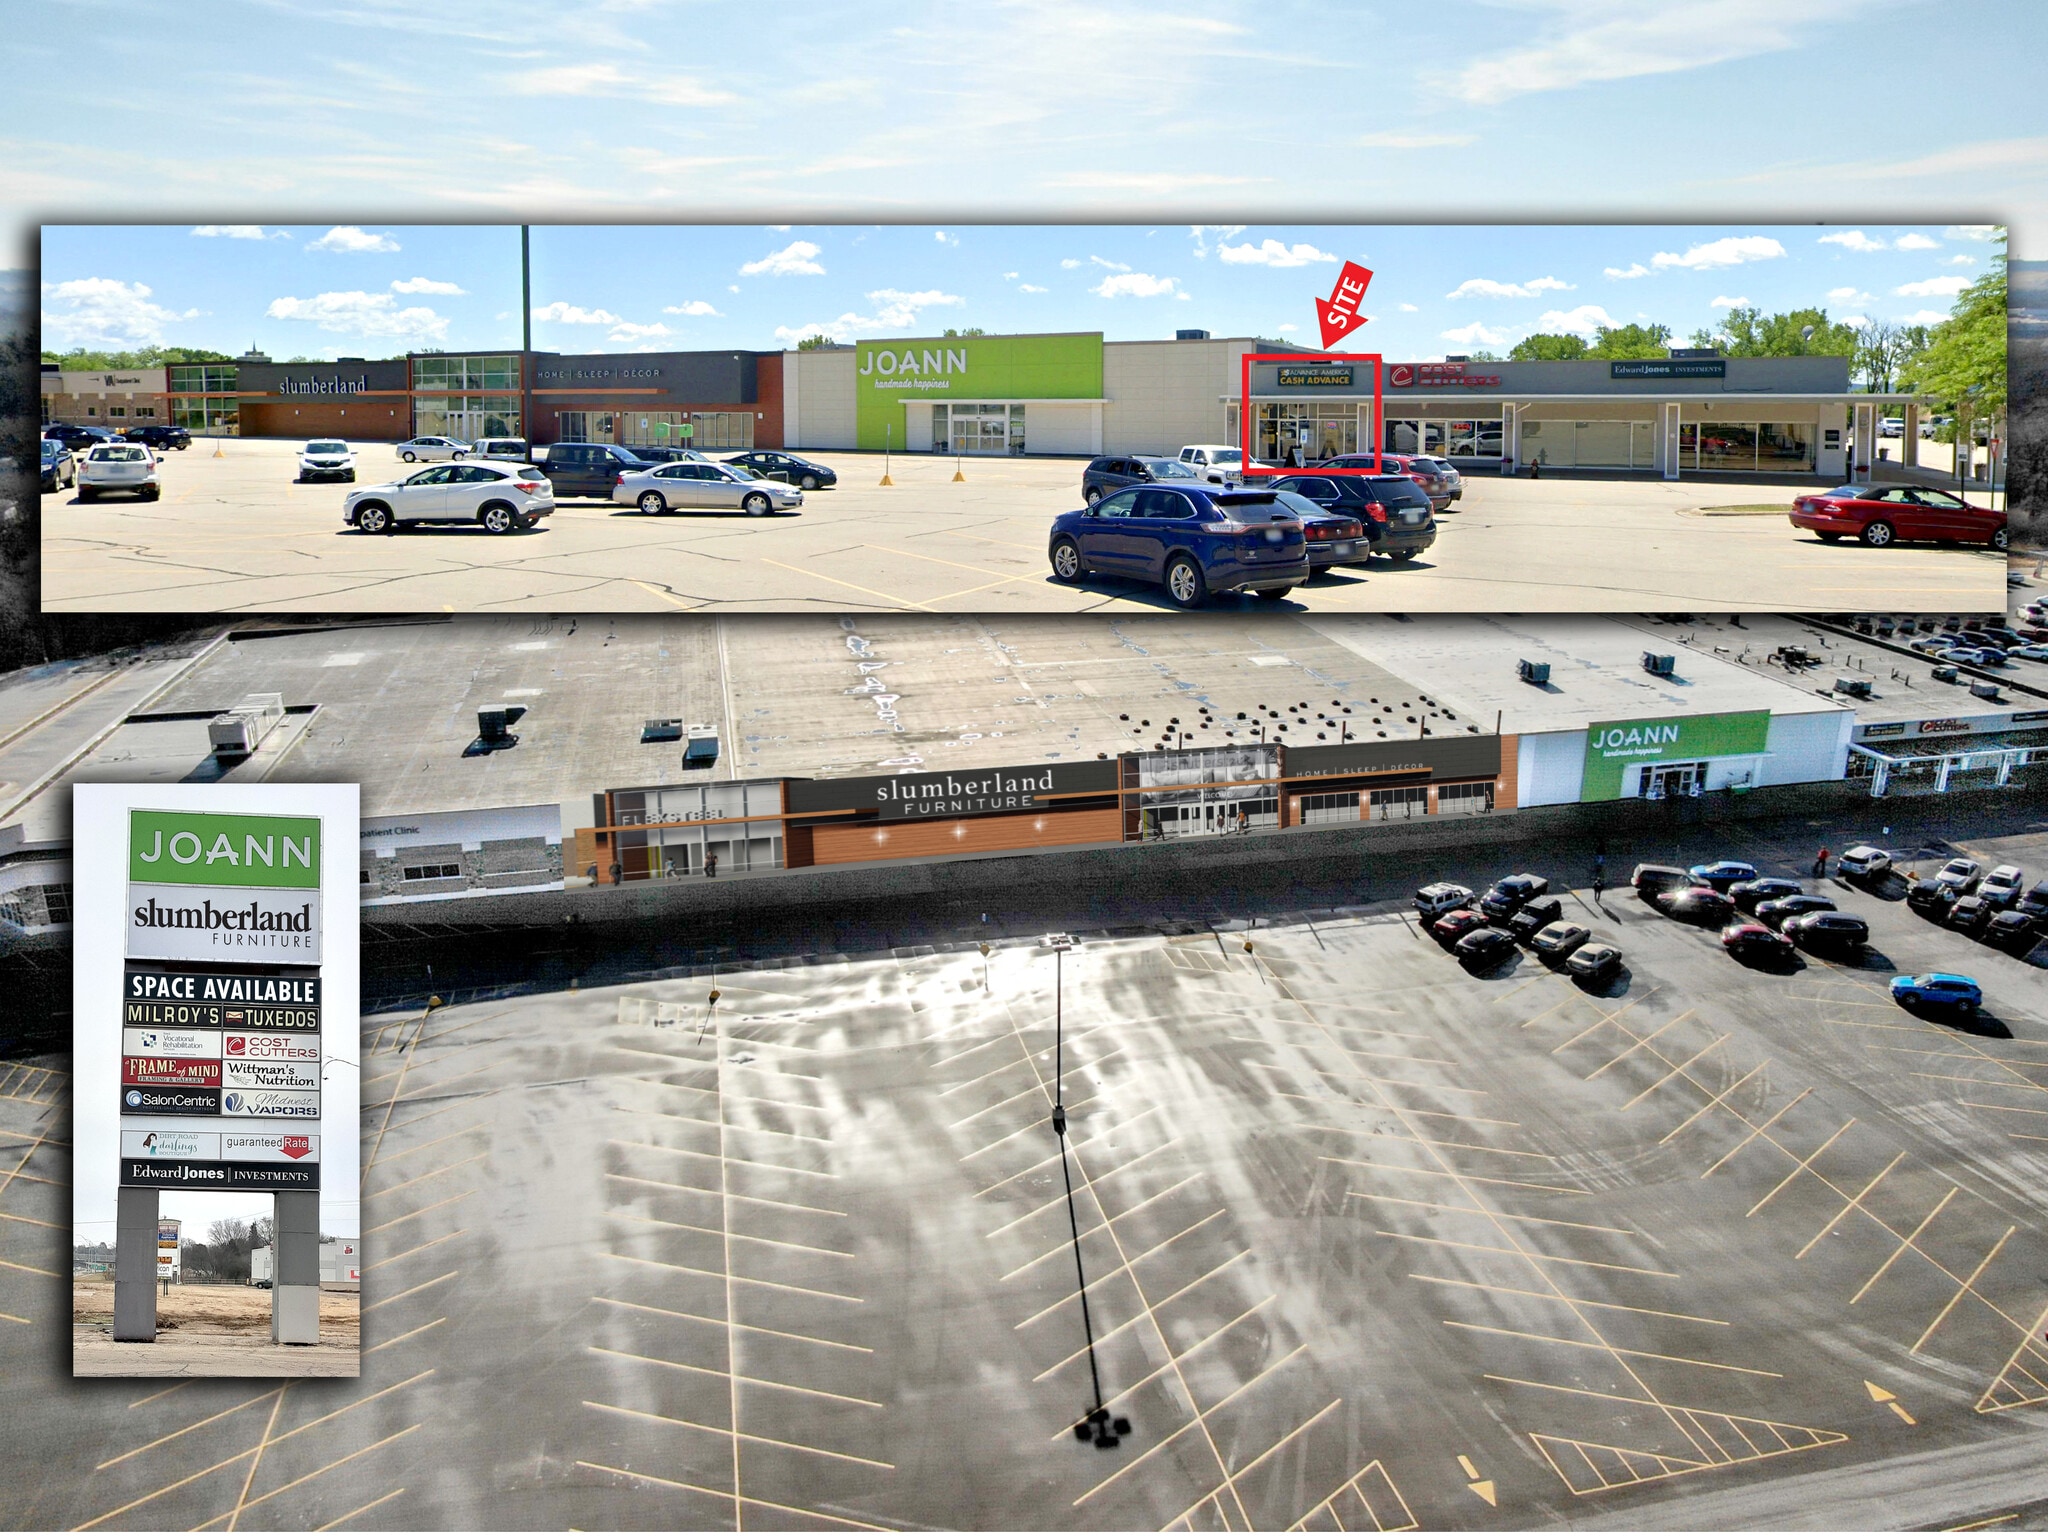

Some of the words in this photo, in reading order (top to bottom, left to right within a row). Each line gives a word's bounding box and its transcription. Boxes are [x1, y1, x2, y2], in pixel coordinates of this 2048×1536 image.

[859, 348, 967, 376] JOANN
[577, 370, 610, 378] SLEEP
[1280, 376, 1305, 384] CASH
[1307, 376, 1350, 384] ADVANCE
[280, 375, 365, 394] slumberland
[874, 378, 913, 389] handmade
[913, 378, 950, 391] happiness
[1592, 724, 1679, 749] JOANN
[1296, 769, 1328, 778] HOME
[1343, 766, 1377, 774] SLEEP
[877, 770, 1054, 801] slumberland
[904, 795, 1032, 815] FURNITURE
[394, 826, 420, 835] Clinic
[139, 830, 311, 868] JOANN
[134, 898, 312, 932] slumberland
[213, 932, 311, 948] FURNITURE
[132, 975, 195, 999] SPACE
[203, 978, 314, 1003] AVAILABLE
[127, 1004, 219, 1023] MILROY'S
[245, 1009, 316, 1028] TUXEDOS
[249, 1037, 291, 1047] COST
[249, 1047, 318, 1058] CUTTERS
[129, 1058, 177, 1076] FRAME
[176, 1066, 186, 1077] of
[188, 1064, 219, 1077] MIND
[227, 1062, 295, 1075] Wittman's
[255, 1074, 315, 1086] Nutrition
[142, 1093, 216, 1107] SalonCentric
[255, 1092, 314, 1105] Midwest
[247, 1103, 317, 1116] VAPORS
[159, 1138, 198, 1154] darlings
[227, 1137, 282, 1148] guaranteed
[284, 1137, 308, 1148] Rate
[234, 1170, 309, 1181] INVESTMENTS
